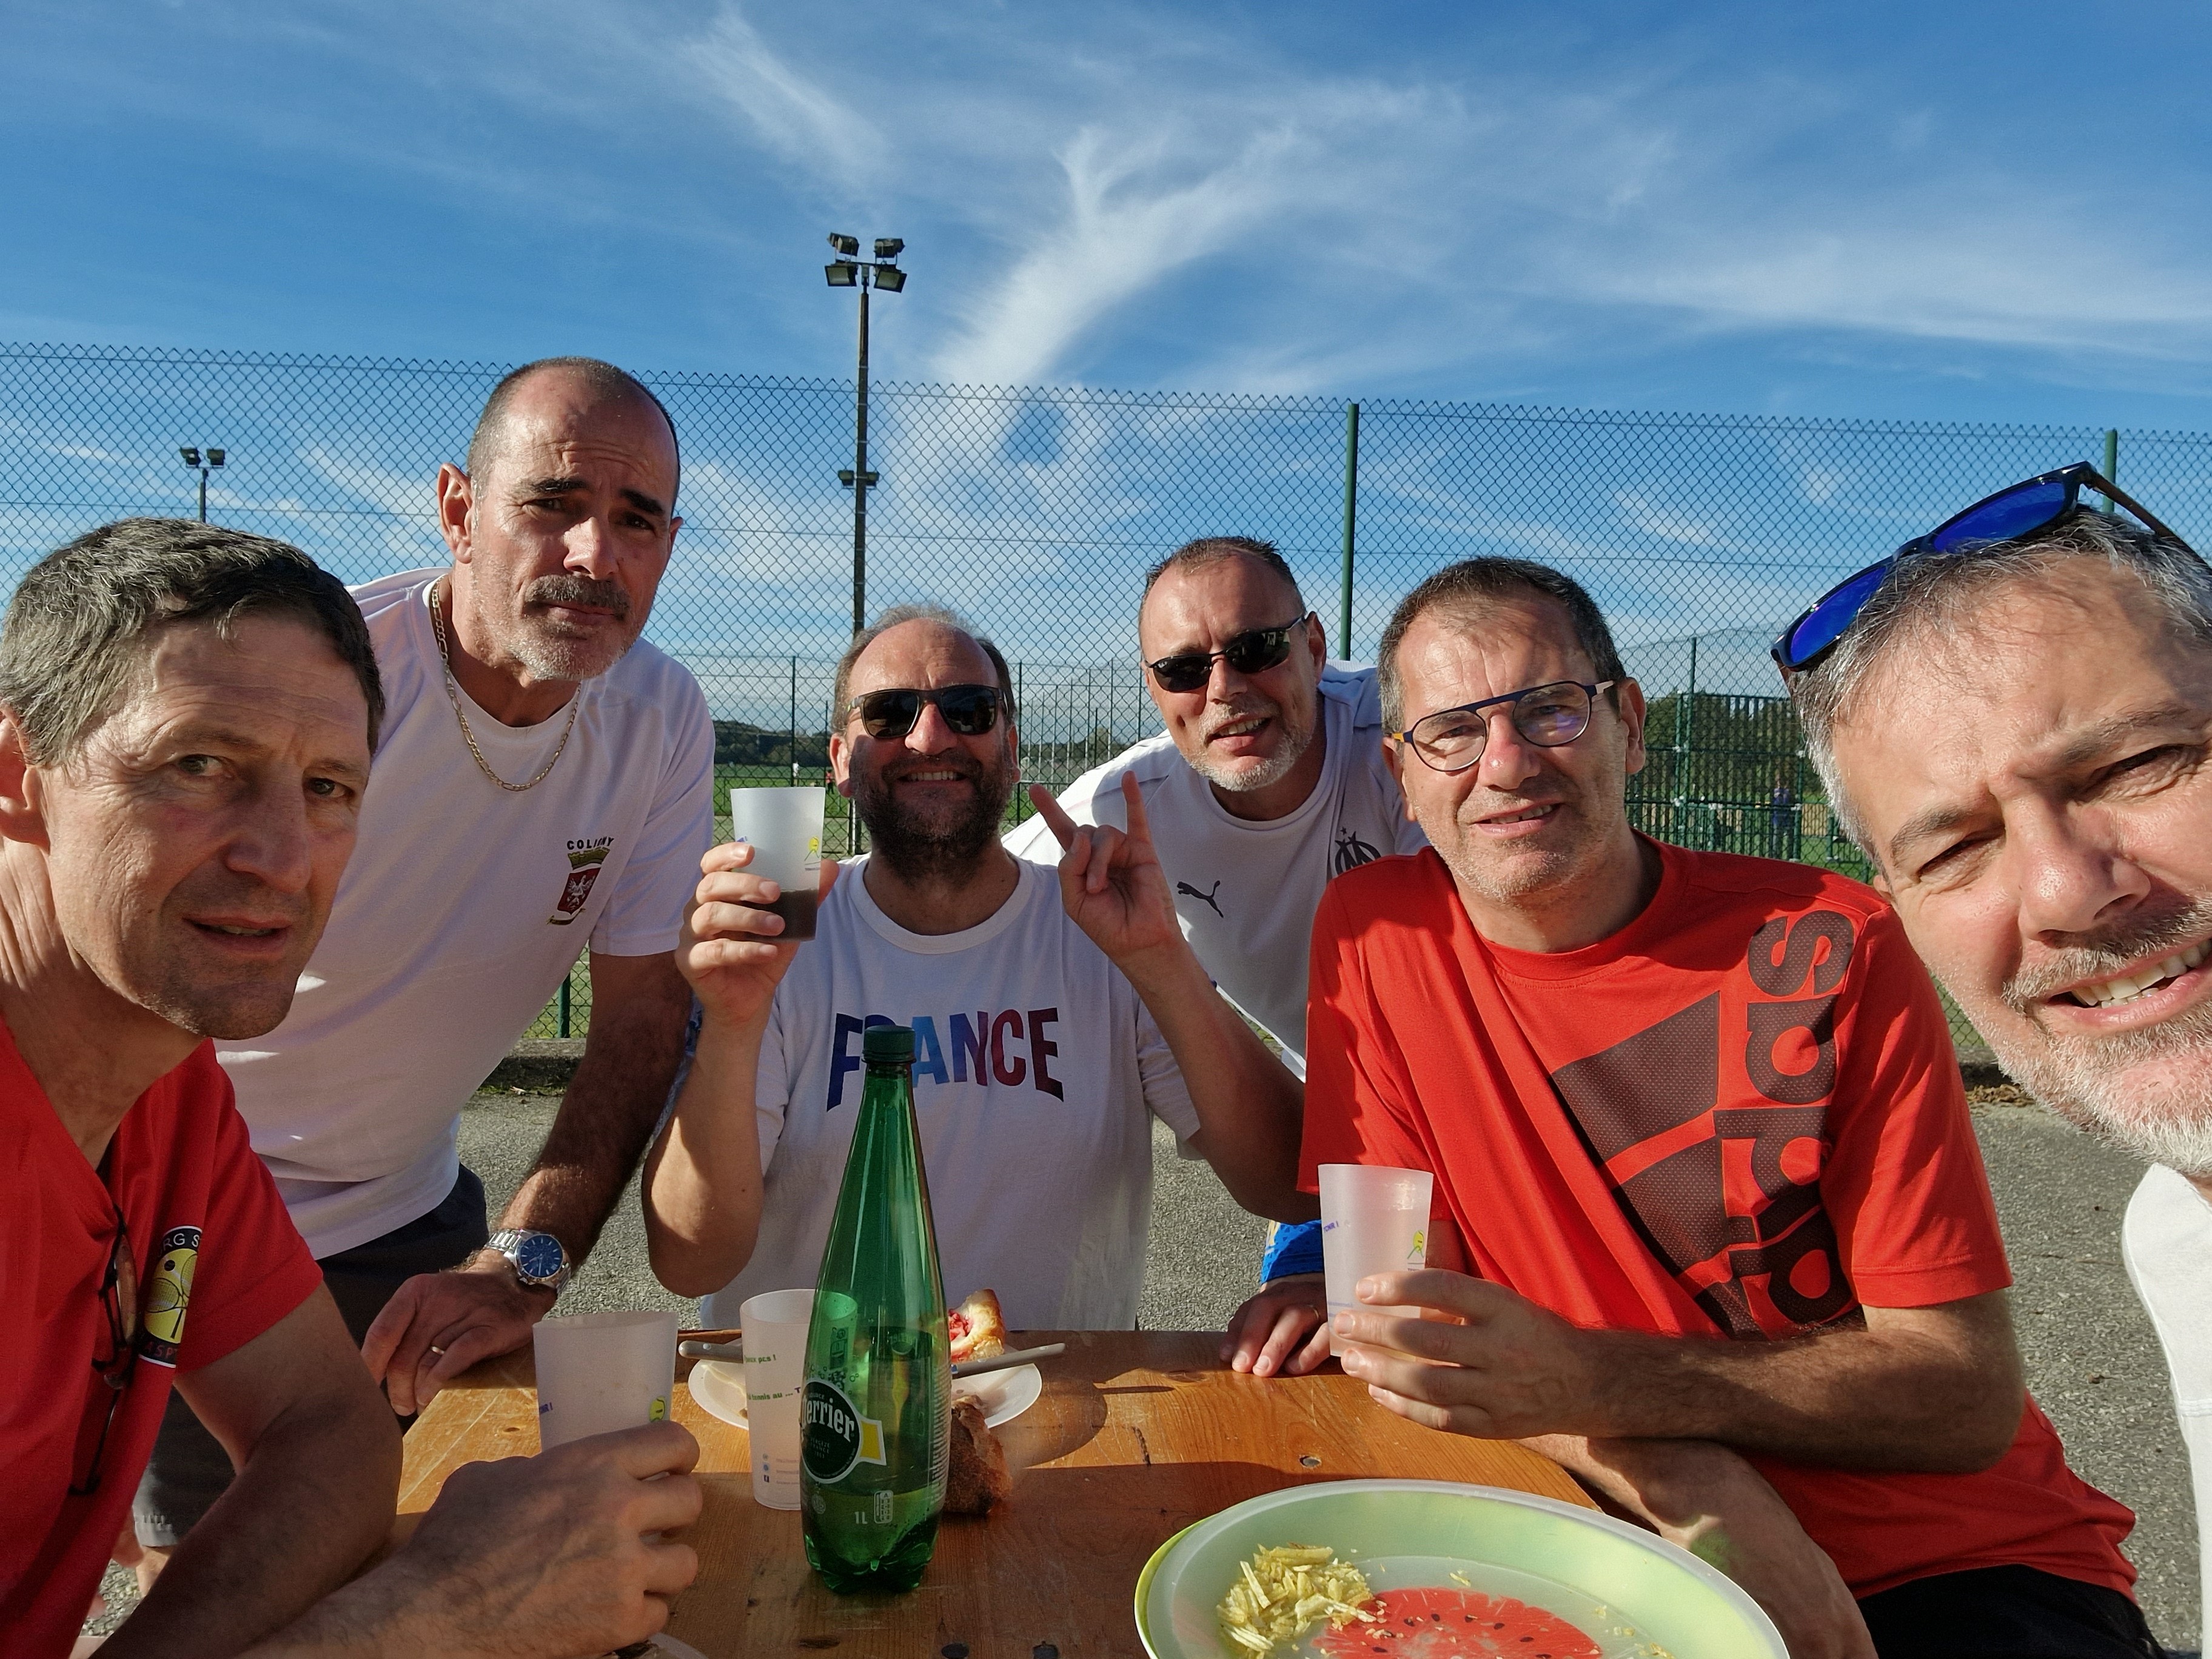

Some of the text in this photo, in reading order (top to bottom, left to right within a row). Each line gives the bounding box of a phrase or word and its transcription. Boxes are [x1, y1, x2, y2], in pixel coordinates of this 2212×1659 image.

[826, 1007, 1064, 1112] FANCE
[1714, 910, 1857, 1330] didas
[854, 1511, 868, 1524] 1L
